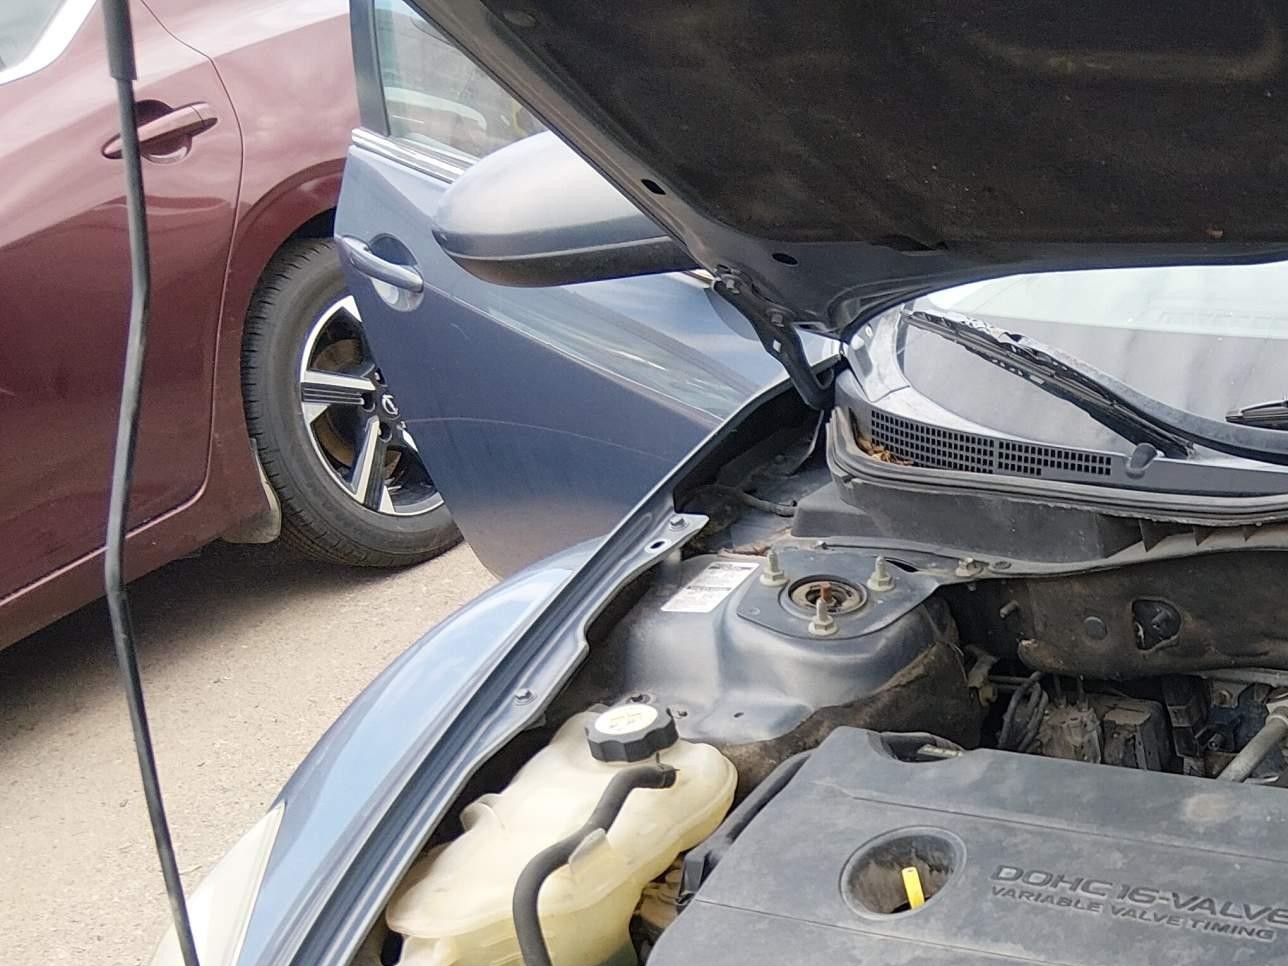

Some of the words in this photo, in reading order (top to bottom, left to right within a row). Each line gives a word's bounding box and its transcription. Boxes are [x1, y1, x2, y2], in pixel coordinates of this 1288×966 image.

[990, 864, 1113, 897] DOHC
[991, 886, 1105, 913] VARIABLE
[1110, 905, 1184, 927] VALVE
[1190, 918, 1276, 941] TIMING
